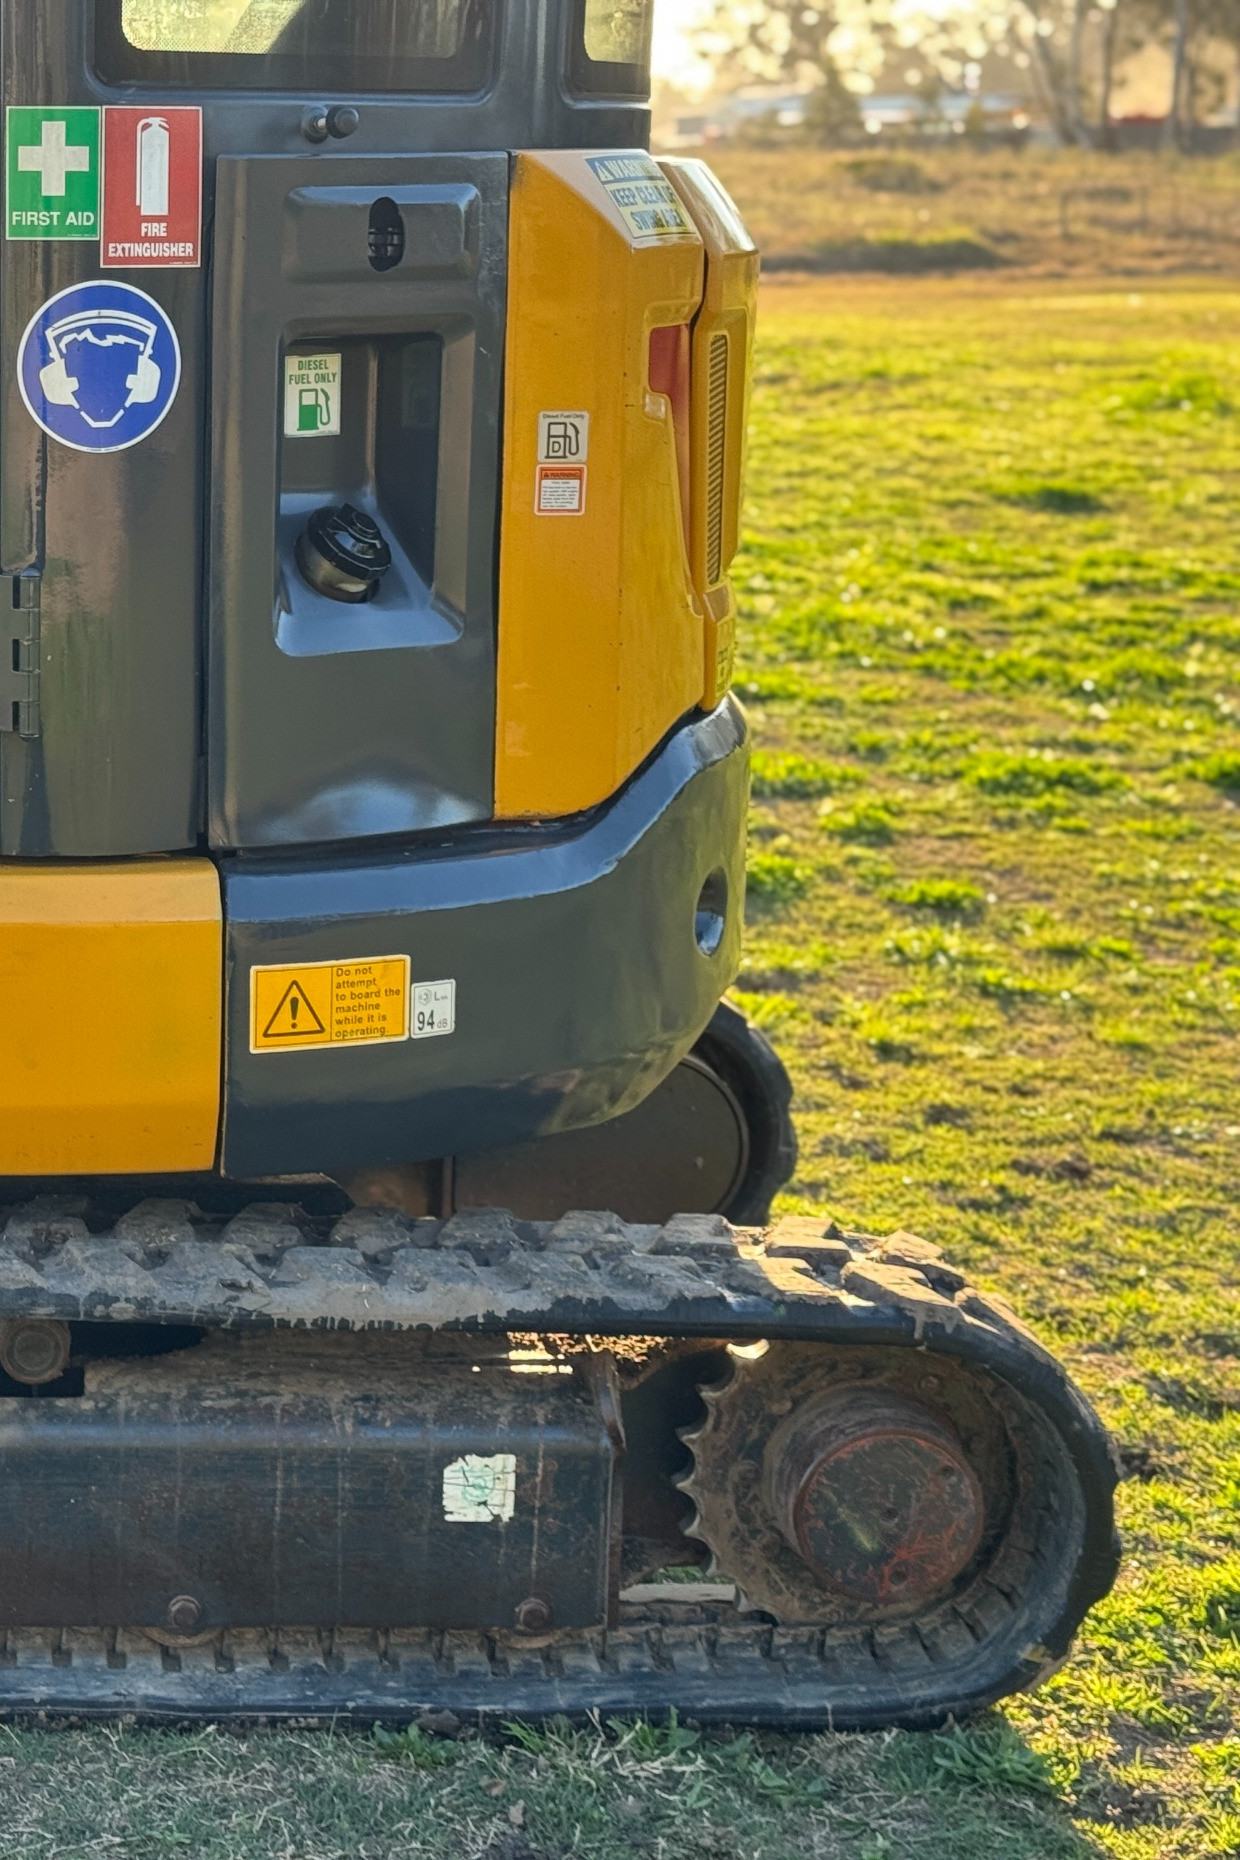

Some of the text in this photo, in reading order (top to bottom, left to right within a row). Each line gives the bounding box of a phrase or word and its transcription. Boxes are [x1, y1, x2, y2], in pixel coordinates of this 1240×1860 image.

[610, 187, 638, 208] KEEP
[635, 185, 668, 205] CLEAR
[12, 211, 95, 226] FIRST AID
[630, 209, 665, 231] SWING
[141, 223, 167, 237] FIRE
[108, 243, 194, 258] EXTINGUISHER
[297, 360, 329, 371] DIESEL
[288, 372, 337, 385] FUEL ONLY
[551, 441, 561, 453] D
[336, 966, 373, 977] Do not
[335, 978, 377, 990] attempt
[335, 987, 401, 1002] to board the
[335, 1002, 381, 1014] machine
[335, 1013, 387, 1026] while it is
[417, 1009, 448, 1031] 94 dB
